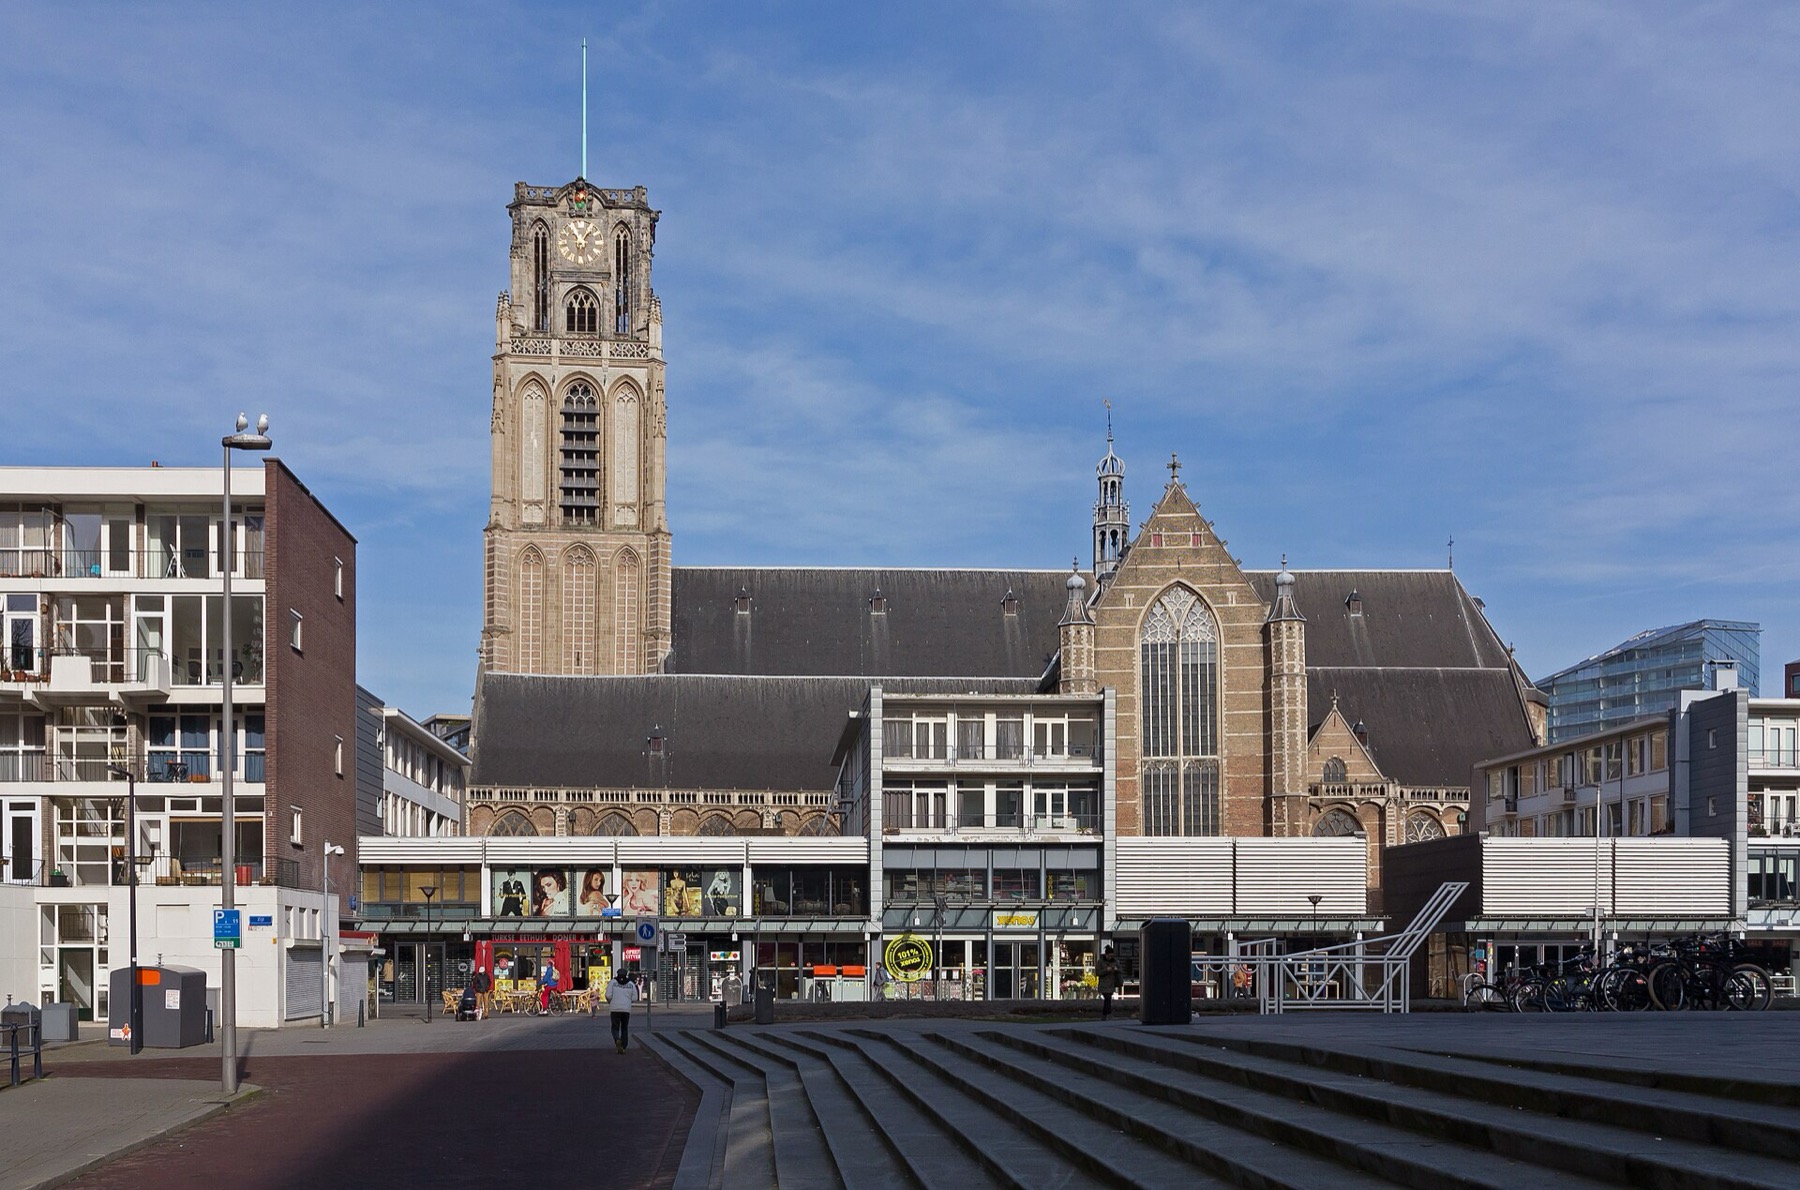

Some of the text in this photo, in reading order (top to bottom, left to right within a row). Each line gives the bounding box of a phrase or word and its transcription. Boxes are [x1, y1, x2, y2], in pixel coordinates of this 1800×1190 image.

[215, 911, 224, 924] P
[997, 915, 1035, 926] xenos
[897, 948, 919, 959] 101%
